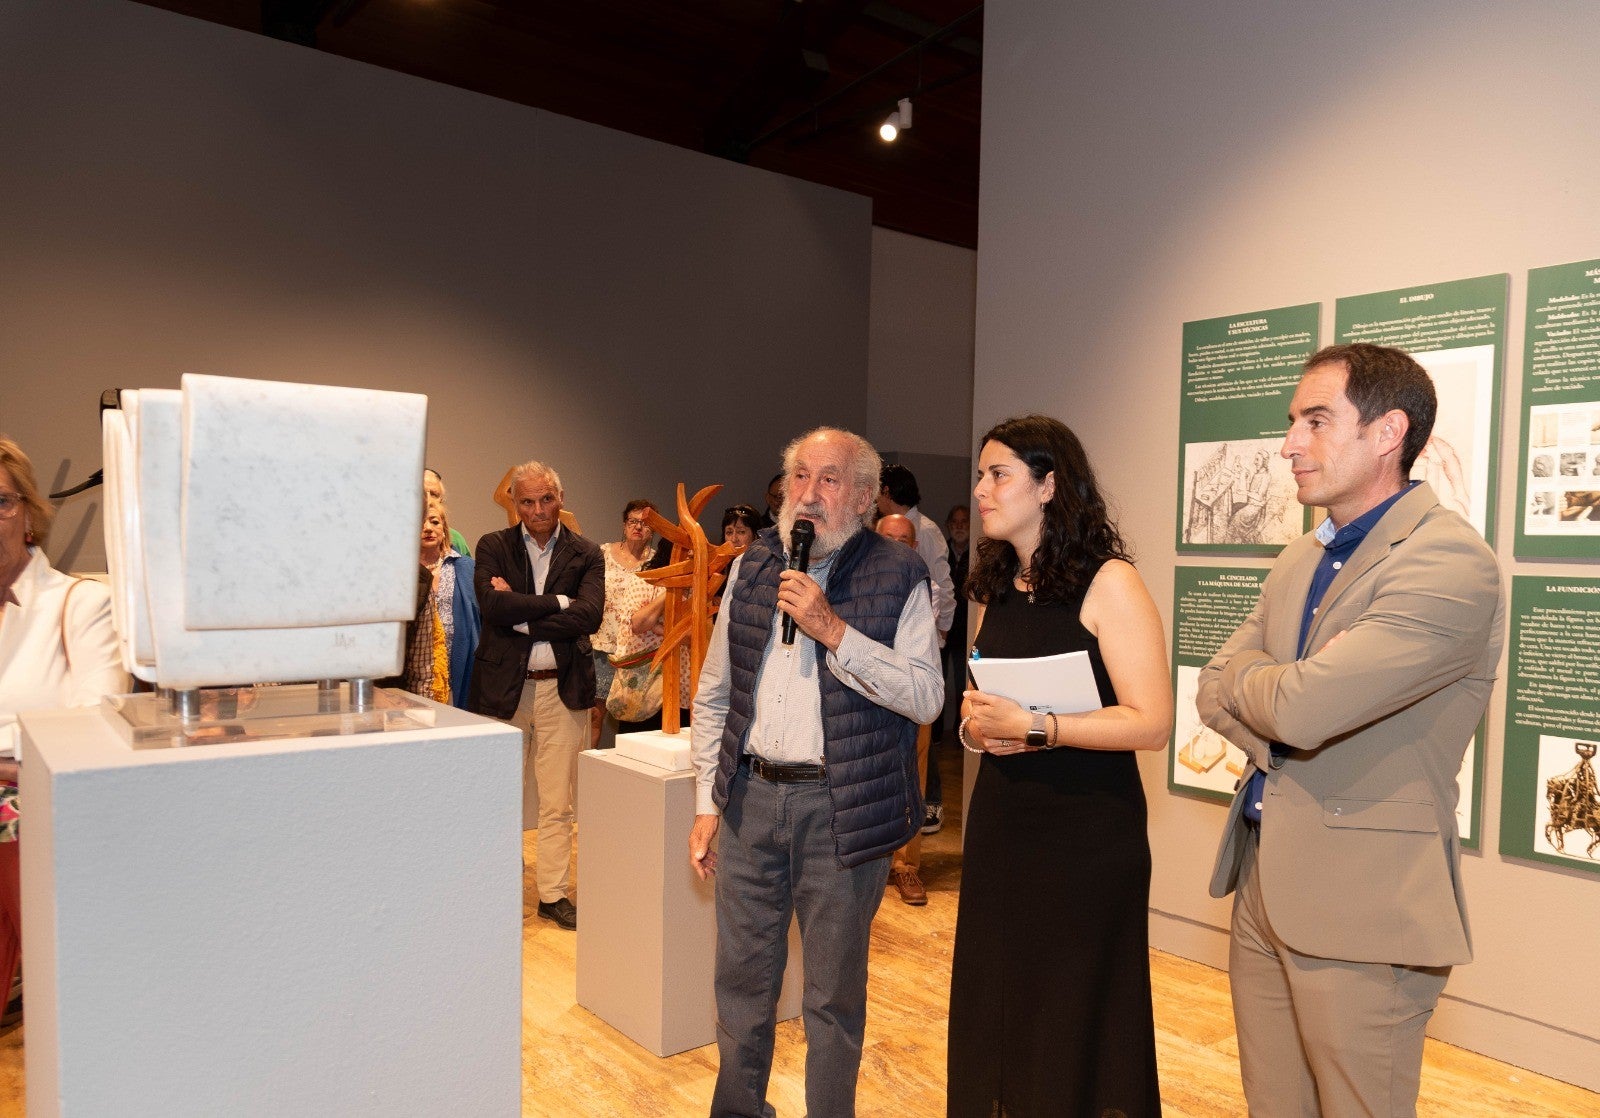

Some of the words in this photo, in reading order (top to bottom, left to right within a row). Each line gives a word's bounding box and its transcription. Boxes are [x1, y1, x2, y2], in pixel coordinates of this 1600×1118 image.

[1408, 293, 1435, 303] DIBUJO
[1237, 318, 1268, 328] ESCULTURA
[1226, 574, 1258, 582] CINCELADO
[1209, 580, 1233, 588] MÁQUINA
